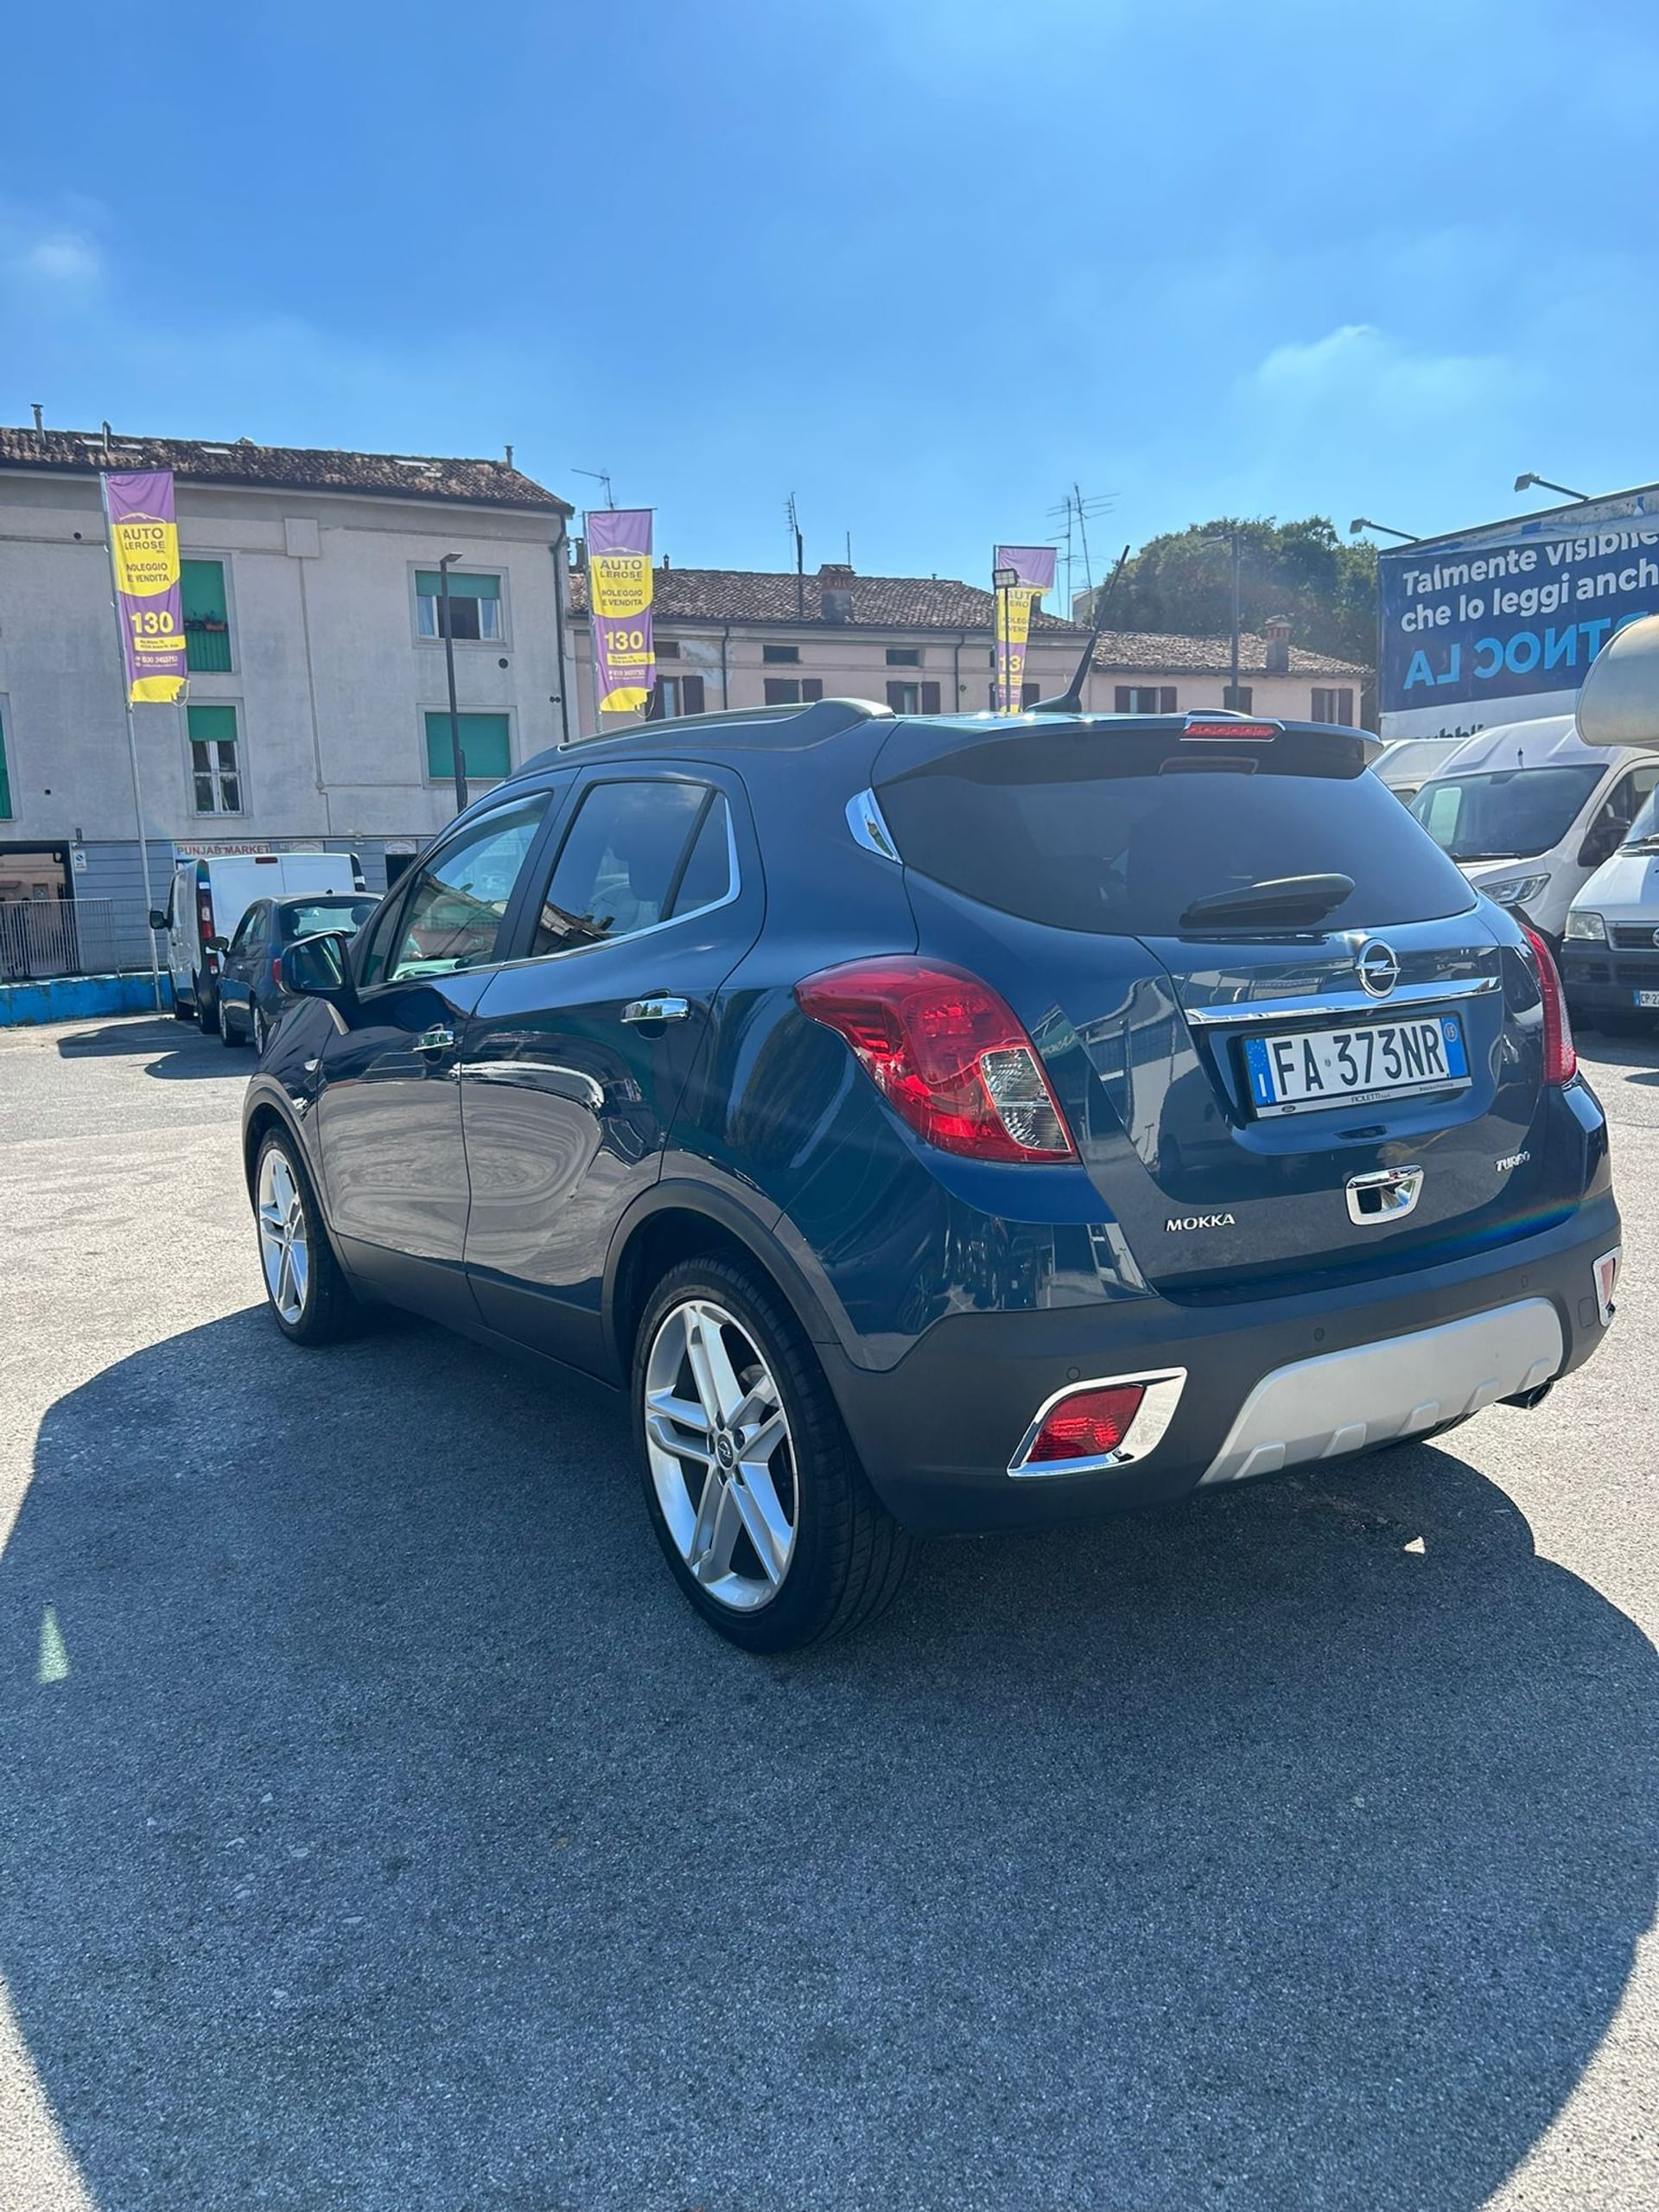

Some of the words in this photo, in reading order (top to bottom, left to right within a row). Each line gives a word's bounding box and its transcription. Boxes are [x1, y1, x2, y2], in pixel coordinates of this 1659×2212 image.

[123, 528, 164, 540] AUTO
[125, 563, 168, 572] NOLEGGIO
[600, 560, 643, 570] AUTO
[127, 574, 134, 582] E
[136, 573, 170, 582] VENDITA
[600, 570, 644, 579] LEROSE
[1401, 549, 1537, 597] Talmente
[608, 598, 644, 607] VENDITA
[1401, 603, 1452, 632] che
[1459, 594, 1484, 621] lo
[1492, 572, 1570, 617] leggi
[131, 611, 174, 634] 130
[605, 631, 644, 650] 130
[999, 655, 1026, 672] 13
[177, 846, 222, 855] PUNJAB
[225, 844, 271, 855] MARKET
[1272, 1039, 1325, 1096] FA
[1332, 1024, 1446, 1087] 373NR
[1165, 1212, 1236, 1232] MOKKA
